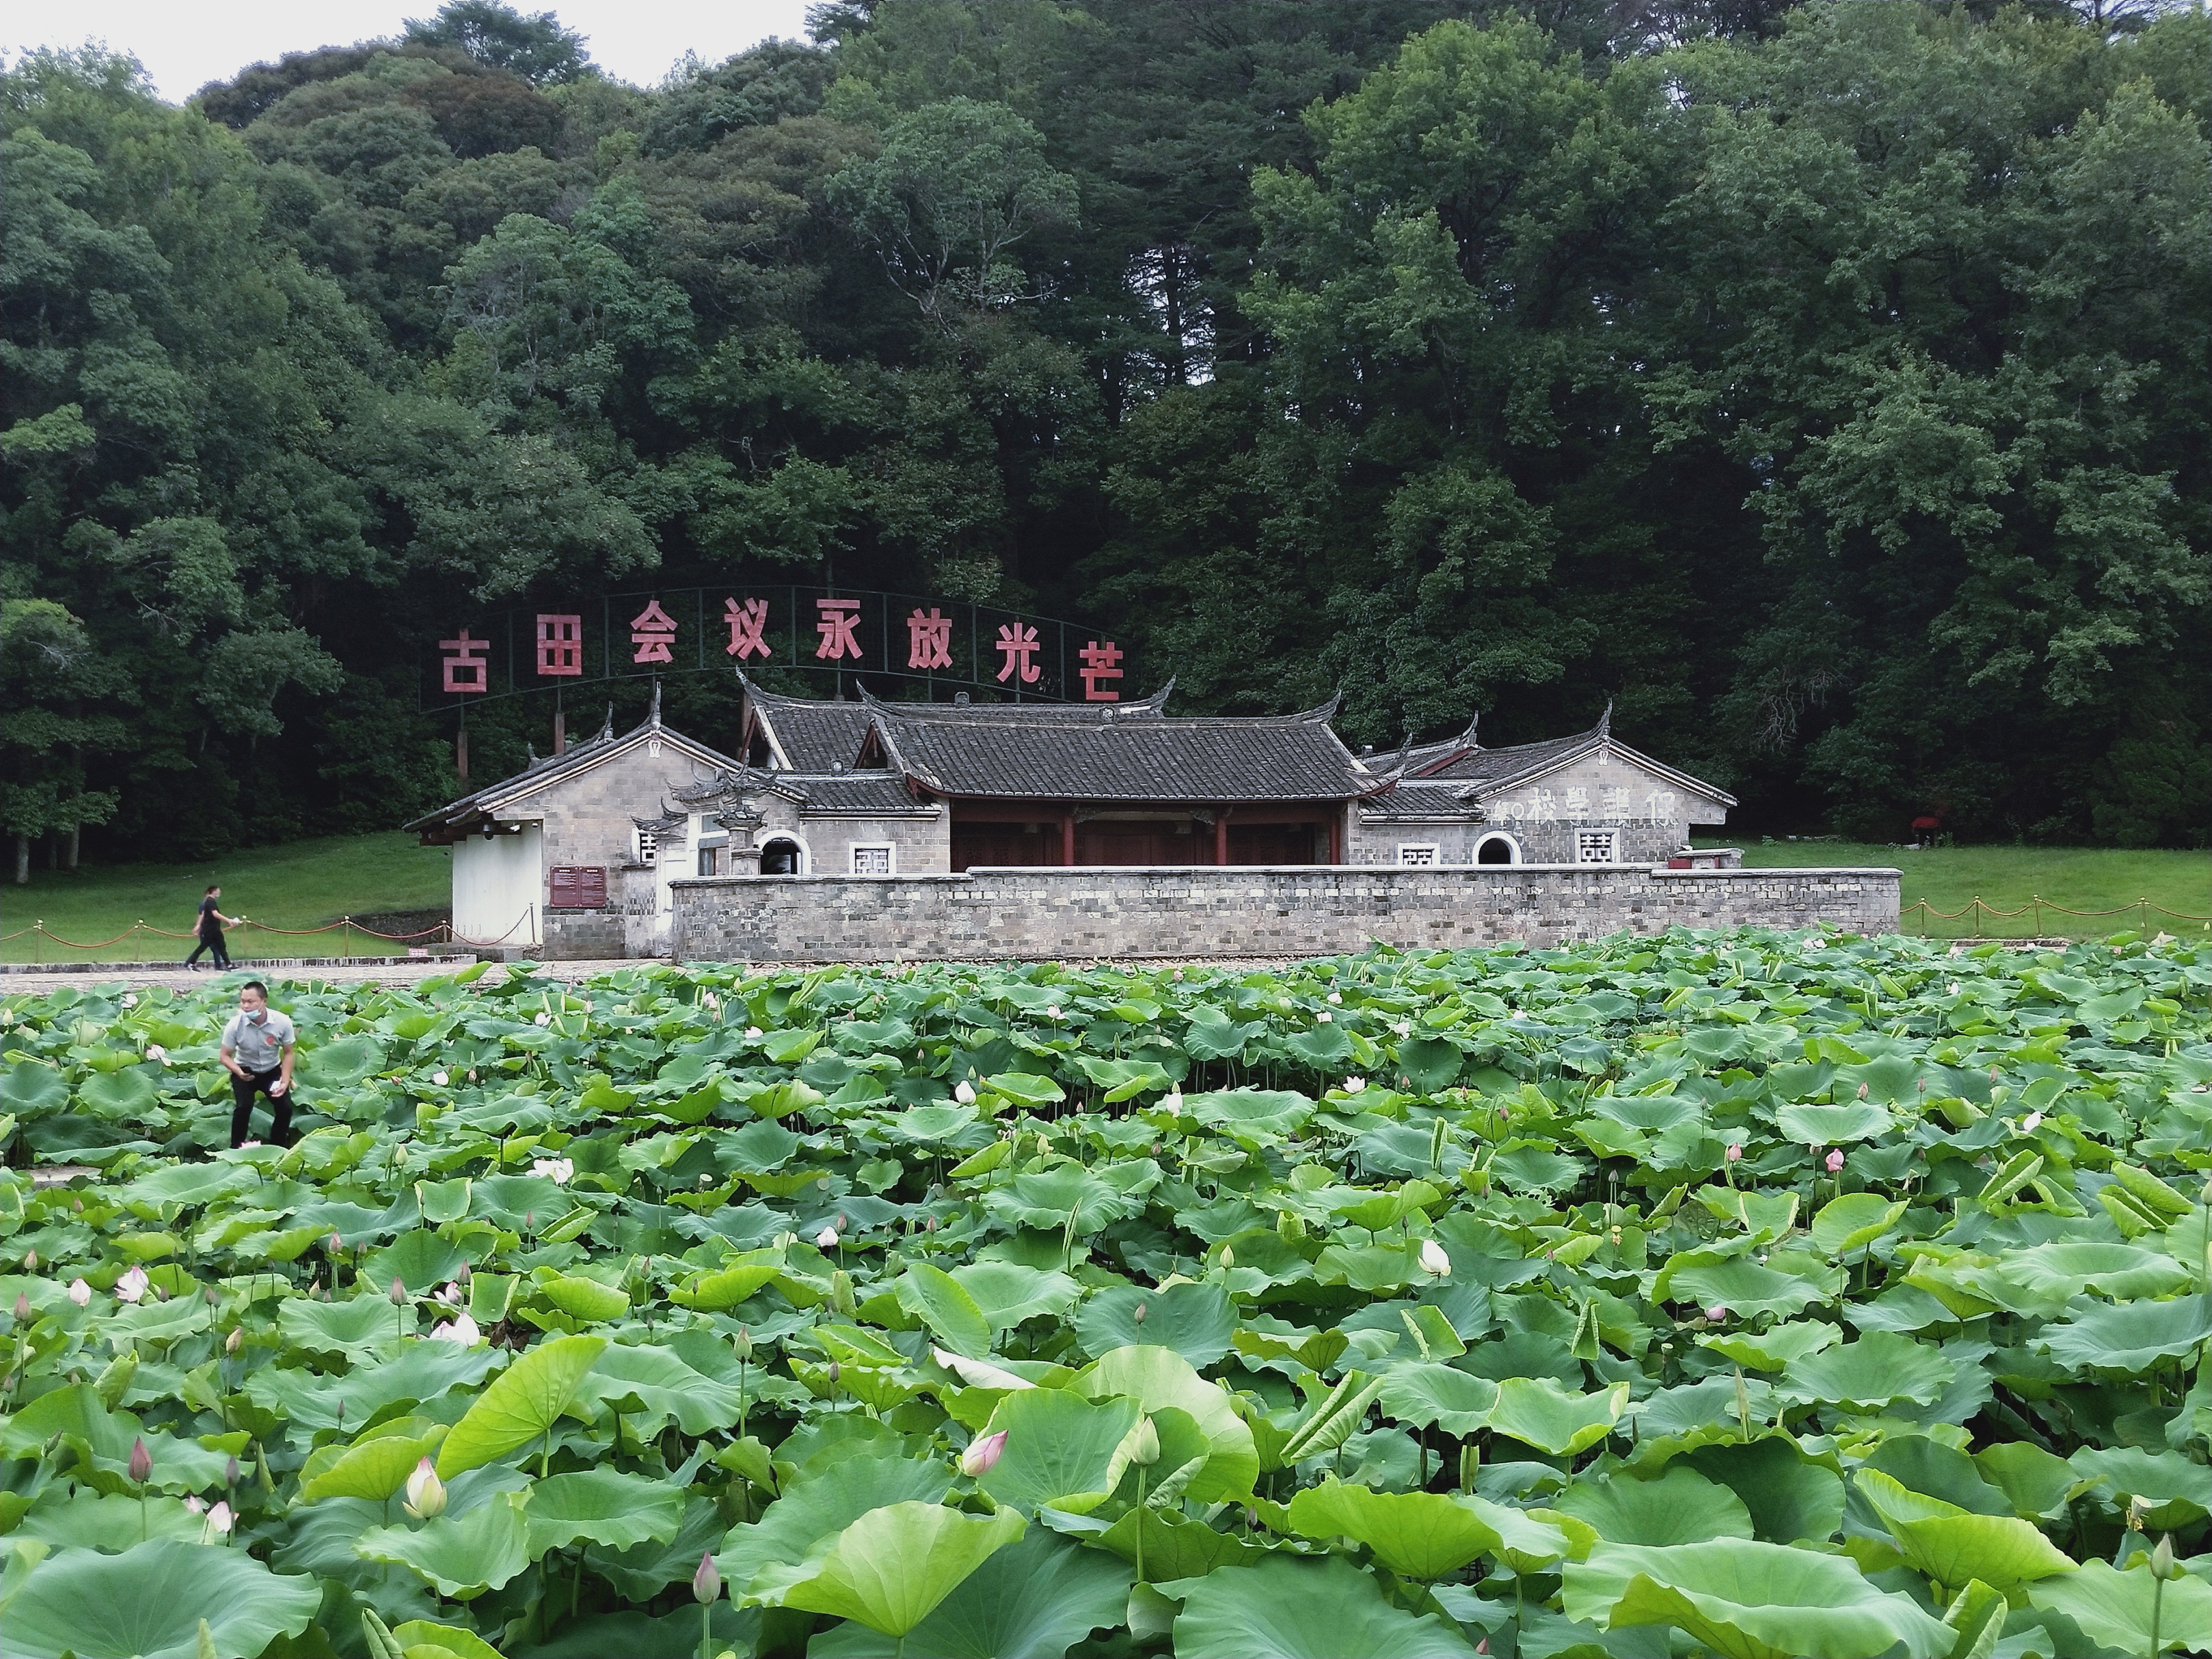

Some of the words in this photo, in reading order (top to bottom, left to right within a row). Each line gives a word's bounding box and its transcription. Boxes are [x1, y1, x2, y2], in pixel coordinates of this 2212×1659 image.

[439, 597, 1124, 701] 古田会议永放光芒
